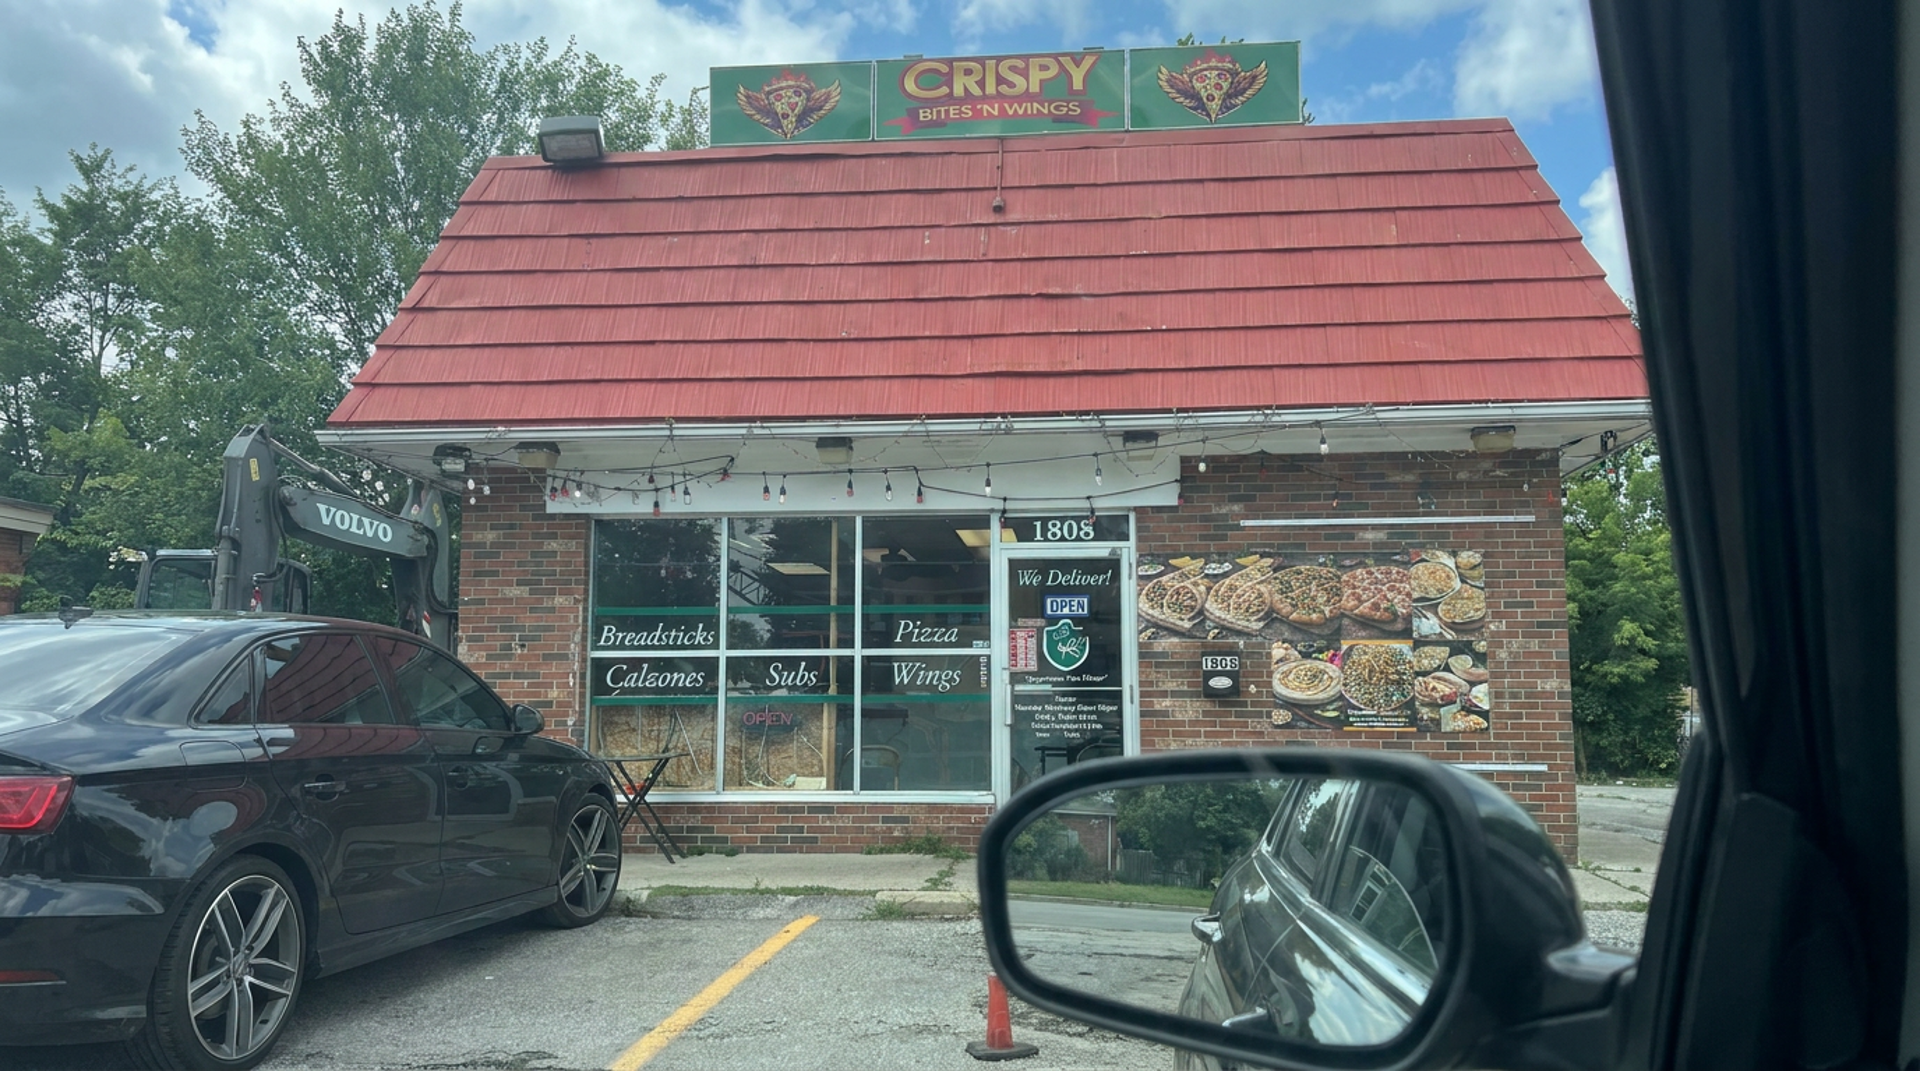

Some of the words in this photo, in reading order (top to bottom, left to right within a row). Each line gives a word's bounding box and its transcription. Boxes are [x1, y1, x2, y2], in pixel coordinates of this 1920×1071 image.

[903, 54, 1099, 98] CRISPY
[919, 105, 972, 121] BITES
[1004, 102, 1081, 116] WINGS
[316, 502, 393, 543] VOLVO
[1033, 520, 1095, 541] 1808
[1018, 570, 1042, 587] We
[1046, 569, 1112, 587] Deliver!
[1050, 599, 1085, 614] OPEN
[597, 623, 715, 647] Breadsticks
[894, 619, 958, 643] Pizza
[606, 663, 705, 688] Calzones
[765, 662, 818, 688] Subs
[892, 661, 961, 693] Wings
[742, 711, 793, 726] OPEN
